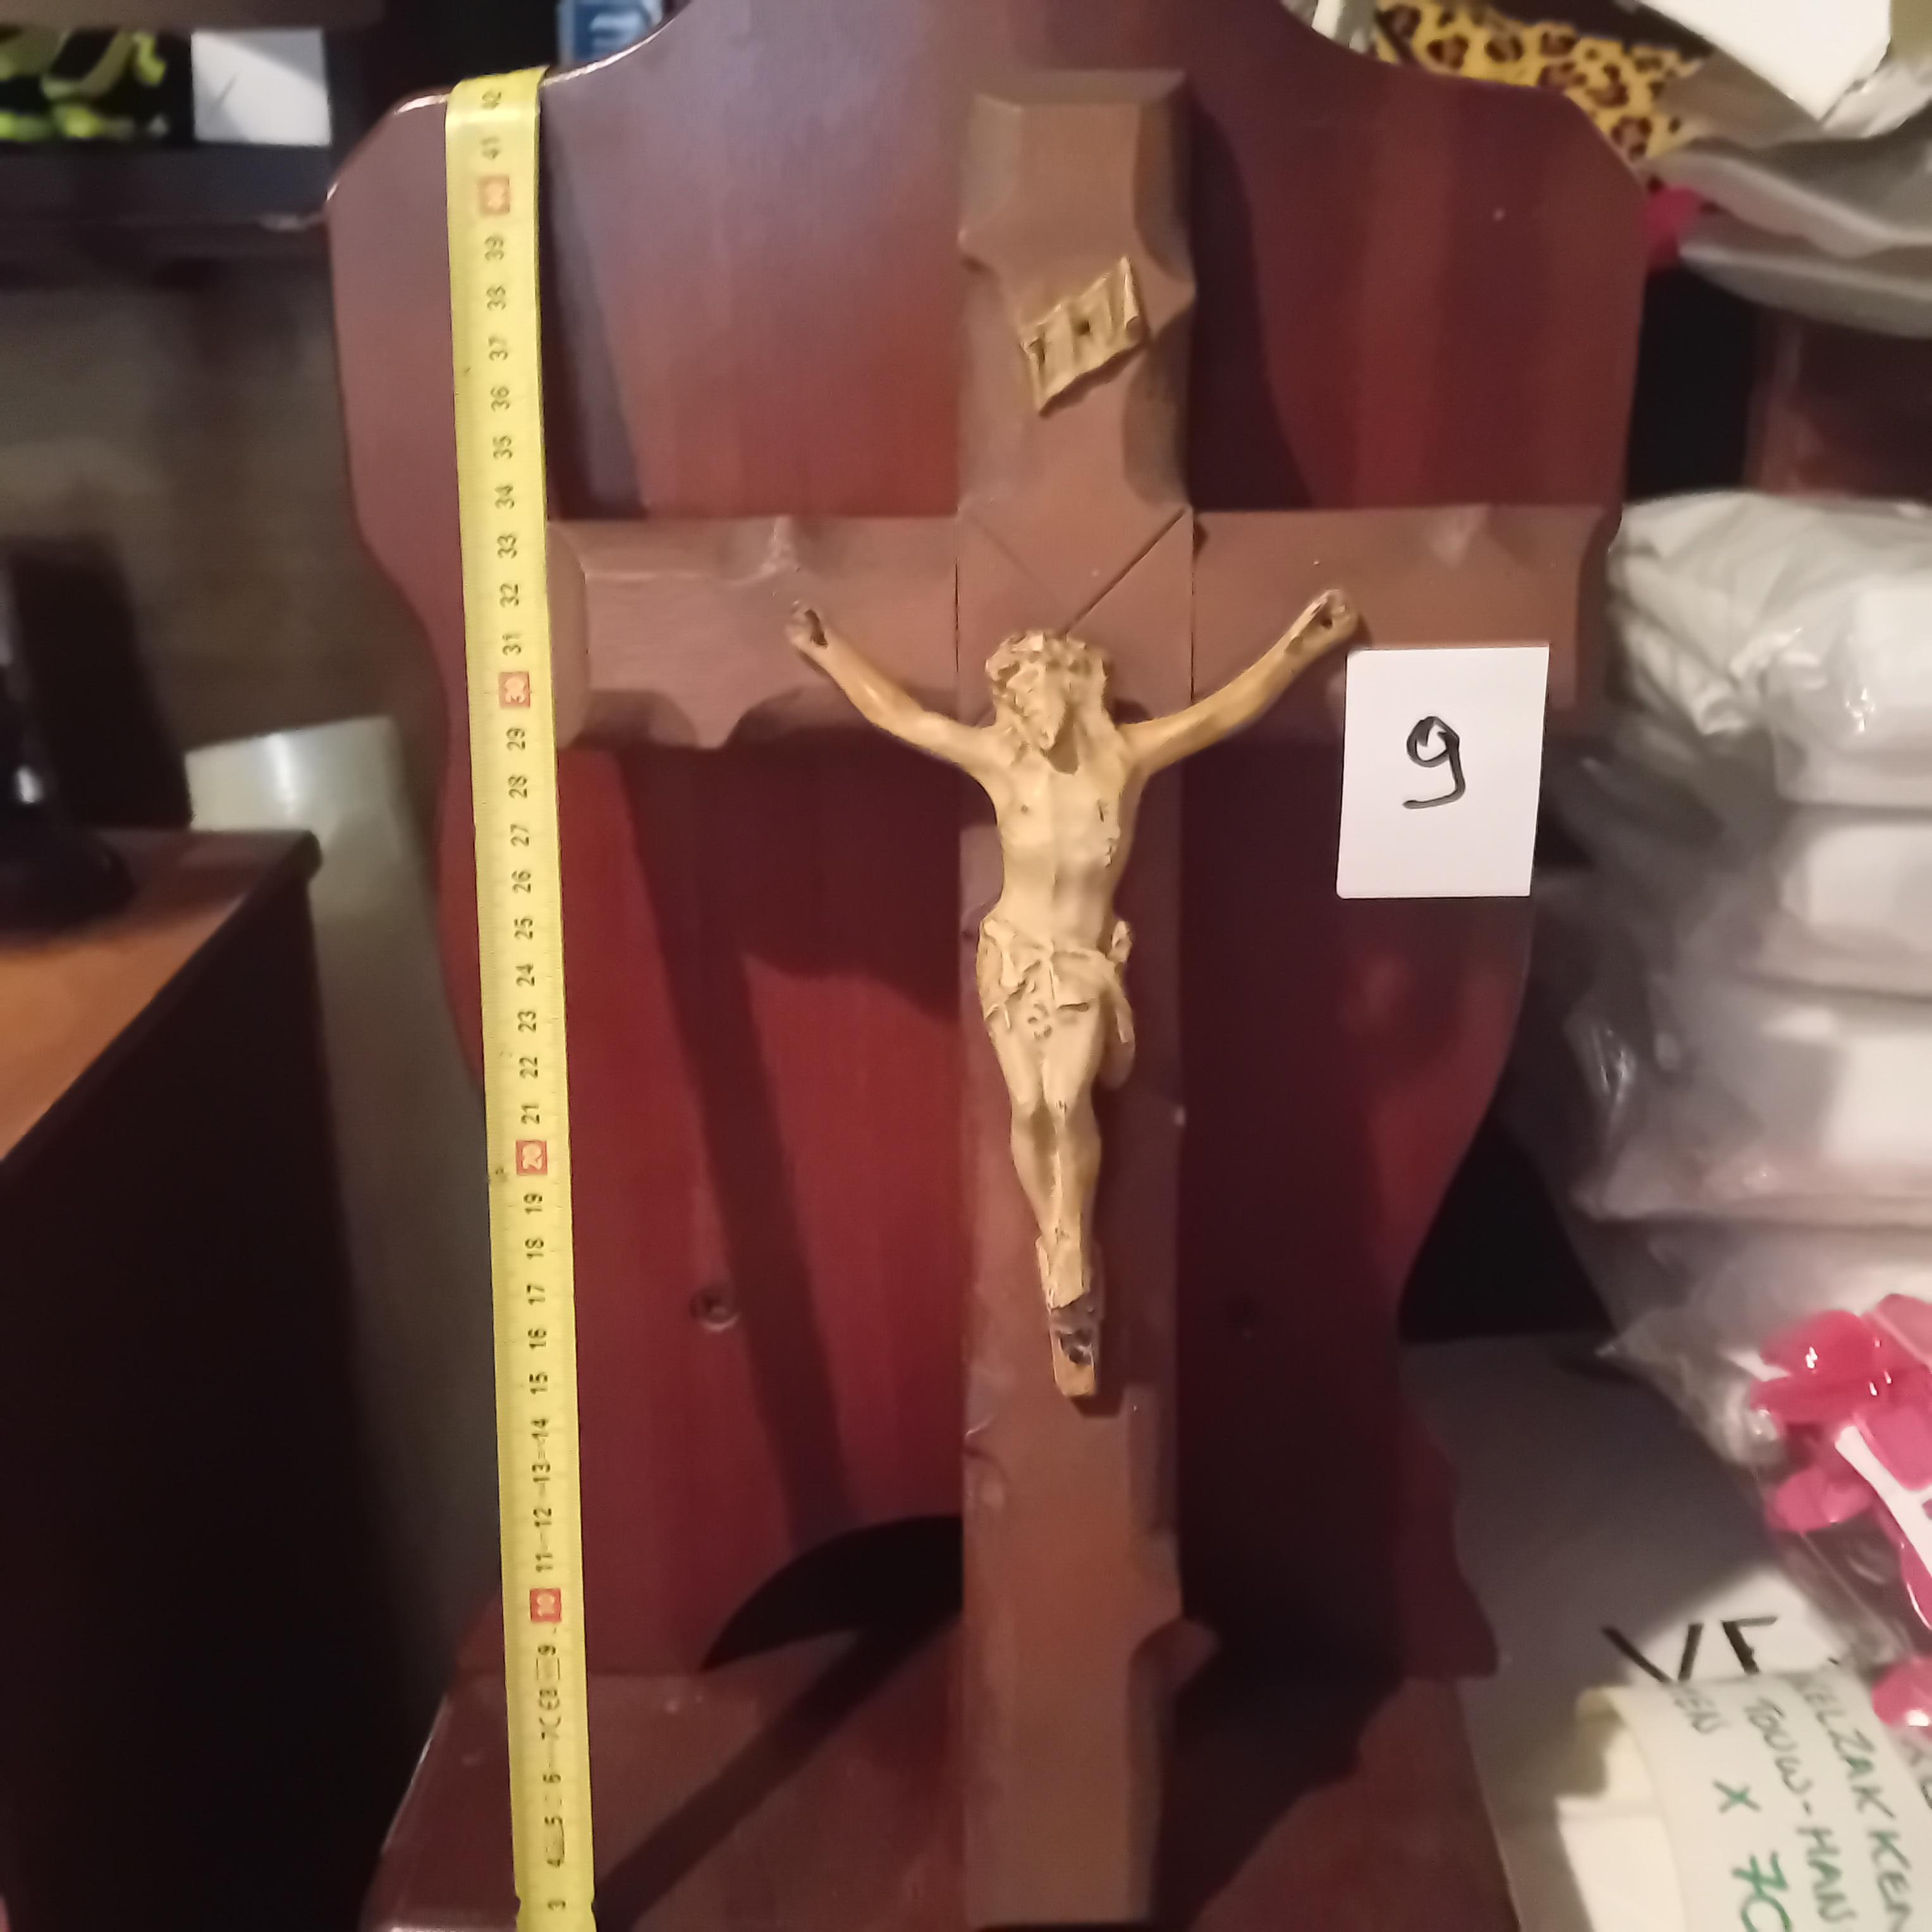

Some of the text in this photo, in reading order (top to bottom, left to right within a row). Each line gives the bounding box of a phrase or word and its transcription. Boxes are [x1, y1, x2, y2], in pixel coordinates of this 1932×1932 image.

[484, 234, 504, 261] 39
[487, 335, 509, 361] 37
[490, 386, 511, 412] 36
[492, 435, 513, 459] 35
[494, 484, 515, 509] 34
[496, 533, 518, 558] 33
[499, 583, 520, 608] 32
[501, 633, 522, 656] 31
[506, 728, 526, 750] 29
[1402, 715, 1467, 810] 9
[508, 774, 528, 798] 28
[510, 823, 530, 847] 27
[511, 870, 532, 893] 26
[513, 917, 534, 939] 25
[515, 963, 535, 987] 24
[517, 1010, 537, 1032] 23
[518, 1056, 539, 1079] 22
[520, 1104, 541, 1125] 21
[523, 1193, 543, 1214] 19
[524, 1238, 544, 1259] 18
[526, 1283, 546, 1305] 17
[527, 1328, 547, 1350] 16
[529, 1372, 548, 1395] 15
[531, 1418, 549, 1438] 14
[532, 1464, 551, 1483] 13
[532, 1508, 552, 1528] 12
[535, 1553, 554, 1573] 11
